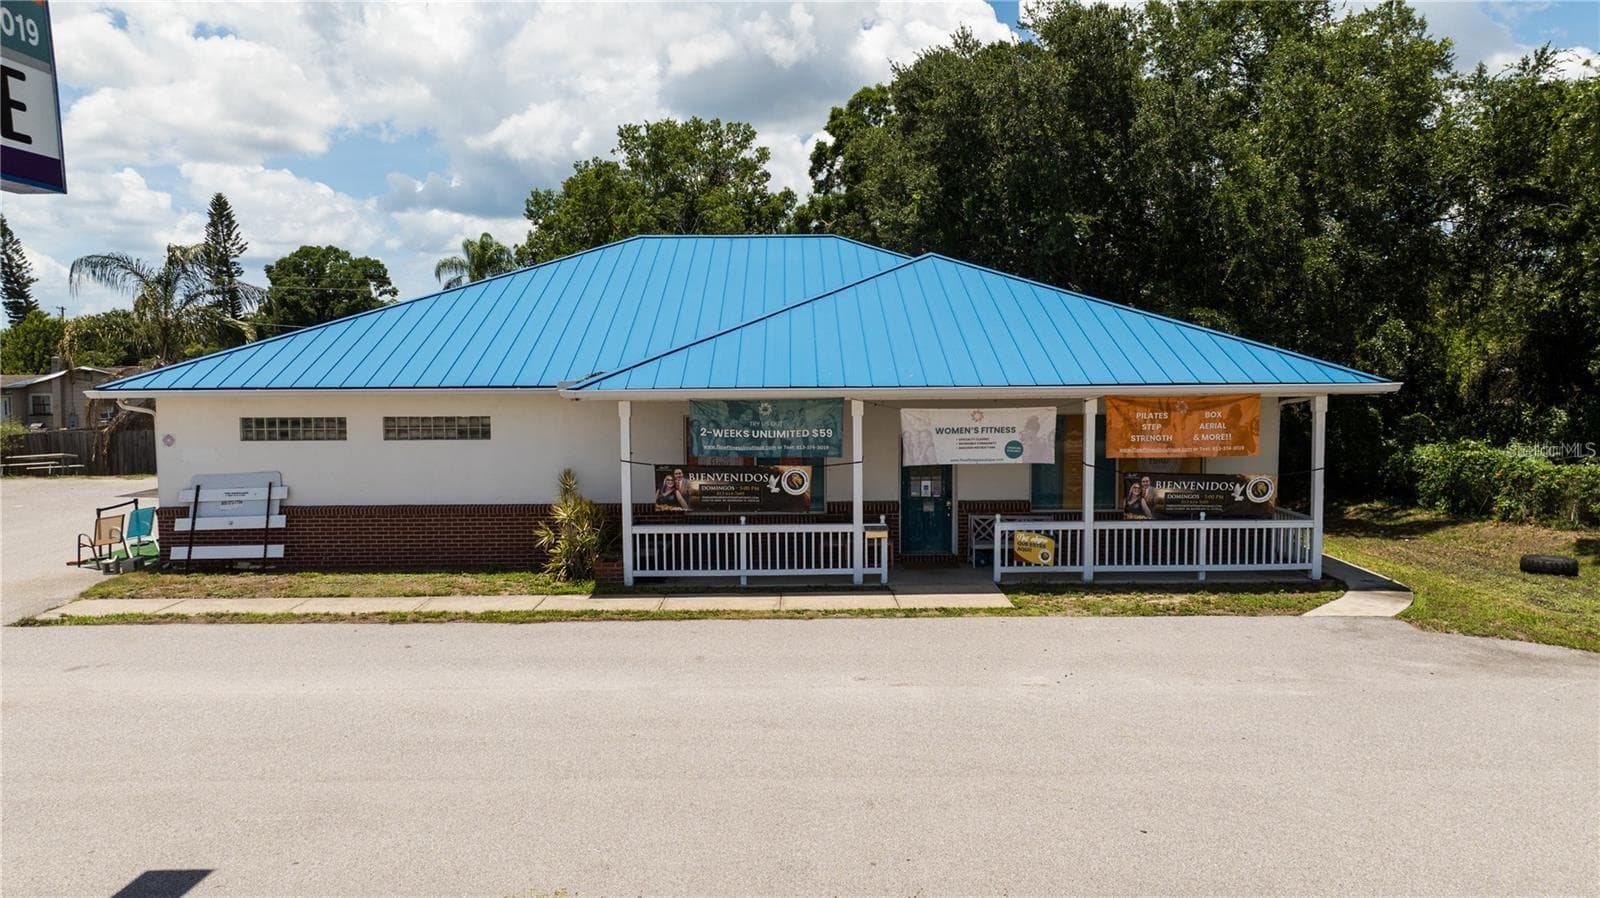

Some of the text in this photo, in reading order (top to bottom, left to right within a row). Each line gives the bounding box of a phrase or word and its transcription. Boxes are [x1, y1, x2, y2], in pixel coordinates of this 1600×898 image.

[1136, 412, 1169, 420] PILATES
[935, 425, 1017, 435] WOMEN'S FITNESS
[1141, 423, 1162, 431] STEP
[1199, 422, 1227, 430] AERIAL
[700, 427, 833, 439] 2-WEEKS UNLIMITED $59
[1193, 432, 1232, 441] & MORE!!
[1130, 434, 1173, 442] STRENGTH
[688, 472, 769, 483] BIENVENIDOS
[1155, 480, 1235, 492] BIENVENIDOS
